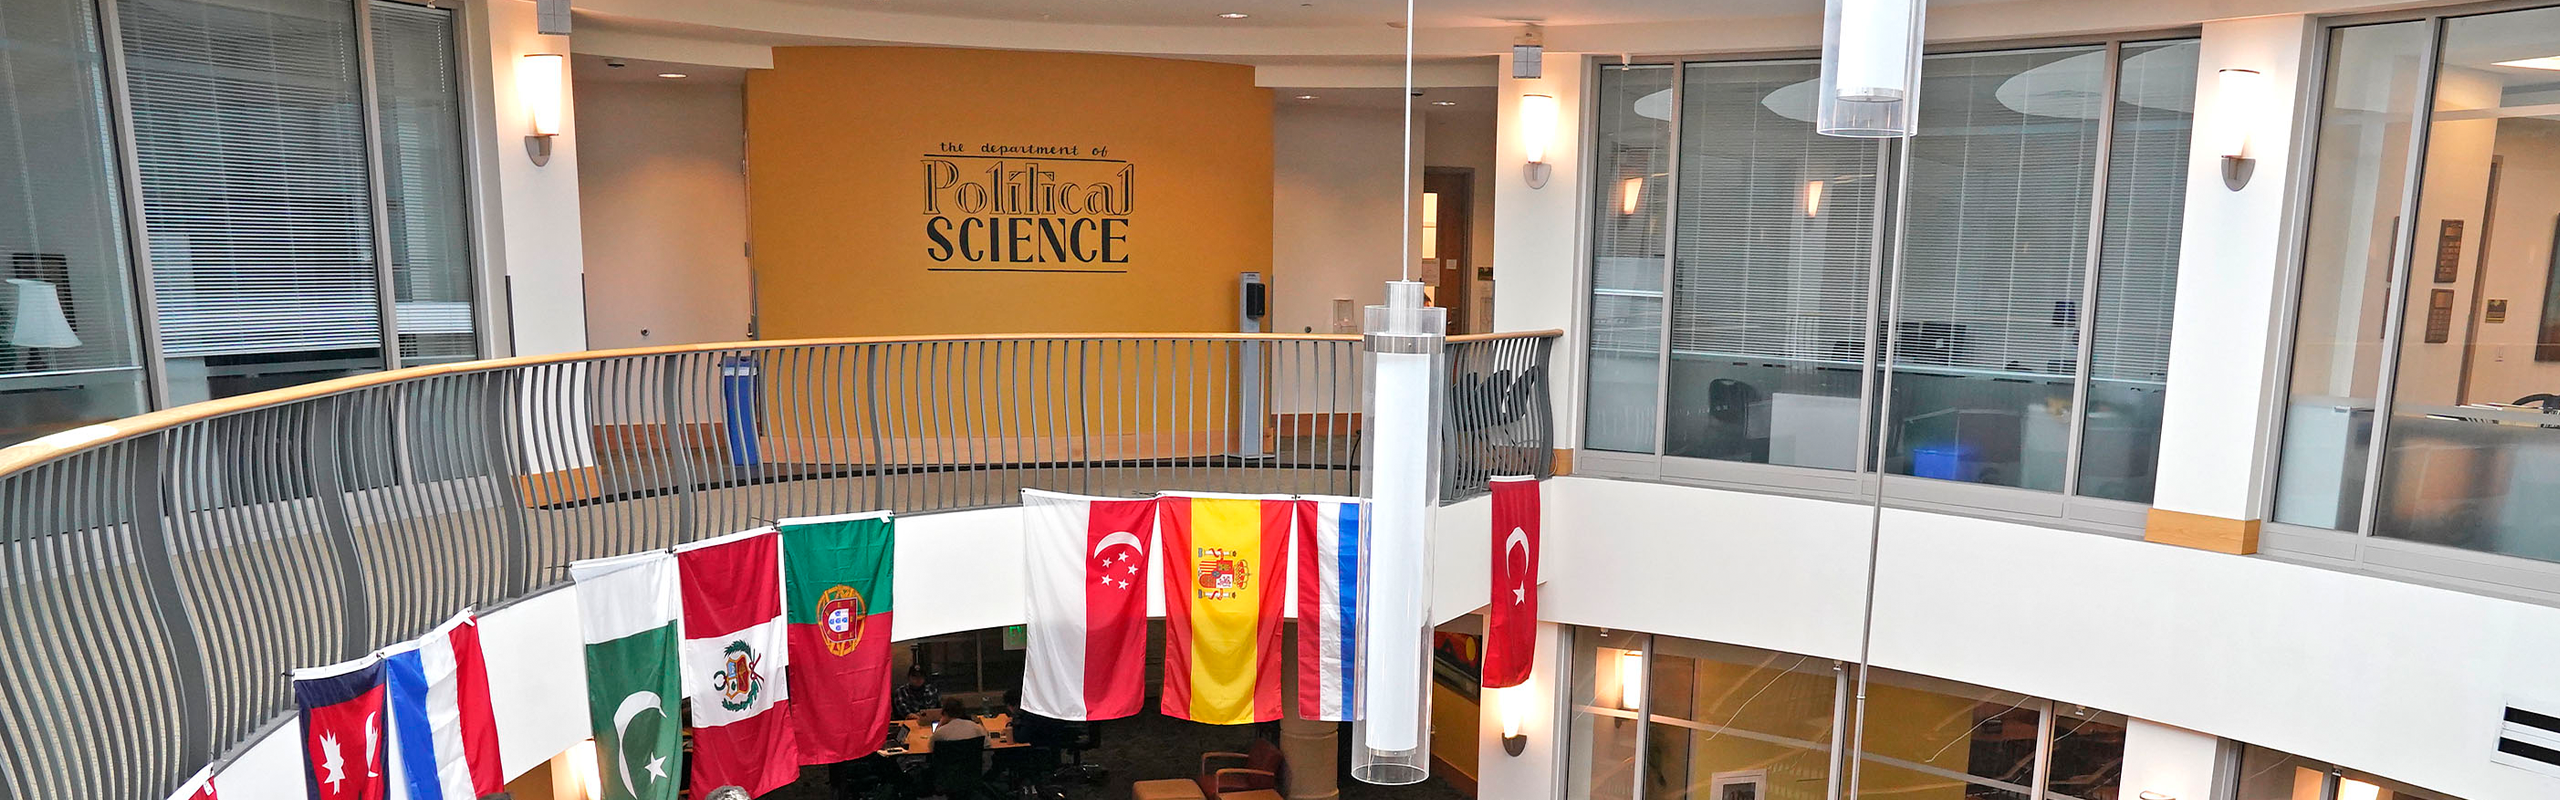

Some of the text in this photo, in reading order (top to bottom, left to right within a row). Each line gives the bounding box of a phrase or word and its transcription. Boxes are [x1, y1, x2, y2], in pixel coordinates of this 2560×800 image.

[940, 142, 1108, 158] the department of
[920, 160, 1134, 216] Political
[926, 216, 1129, 263] SCIENCE
